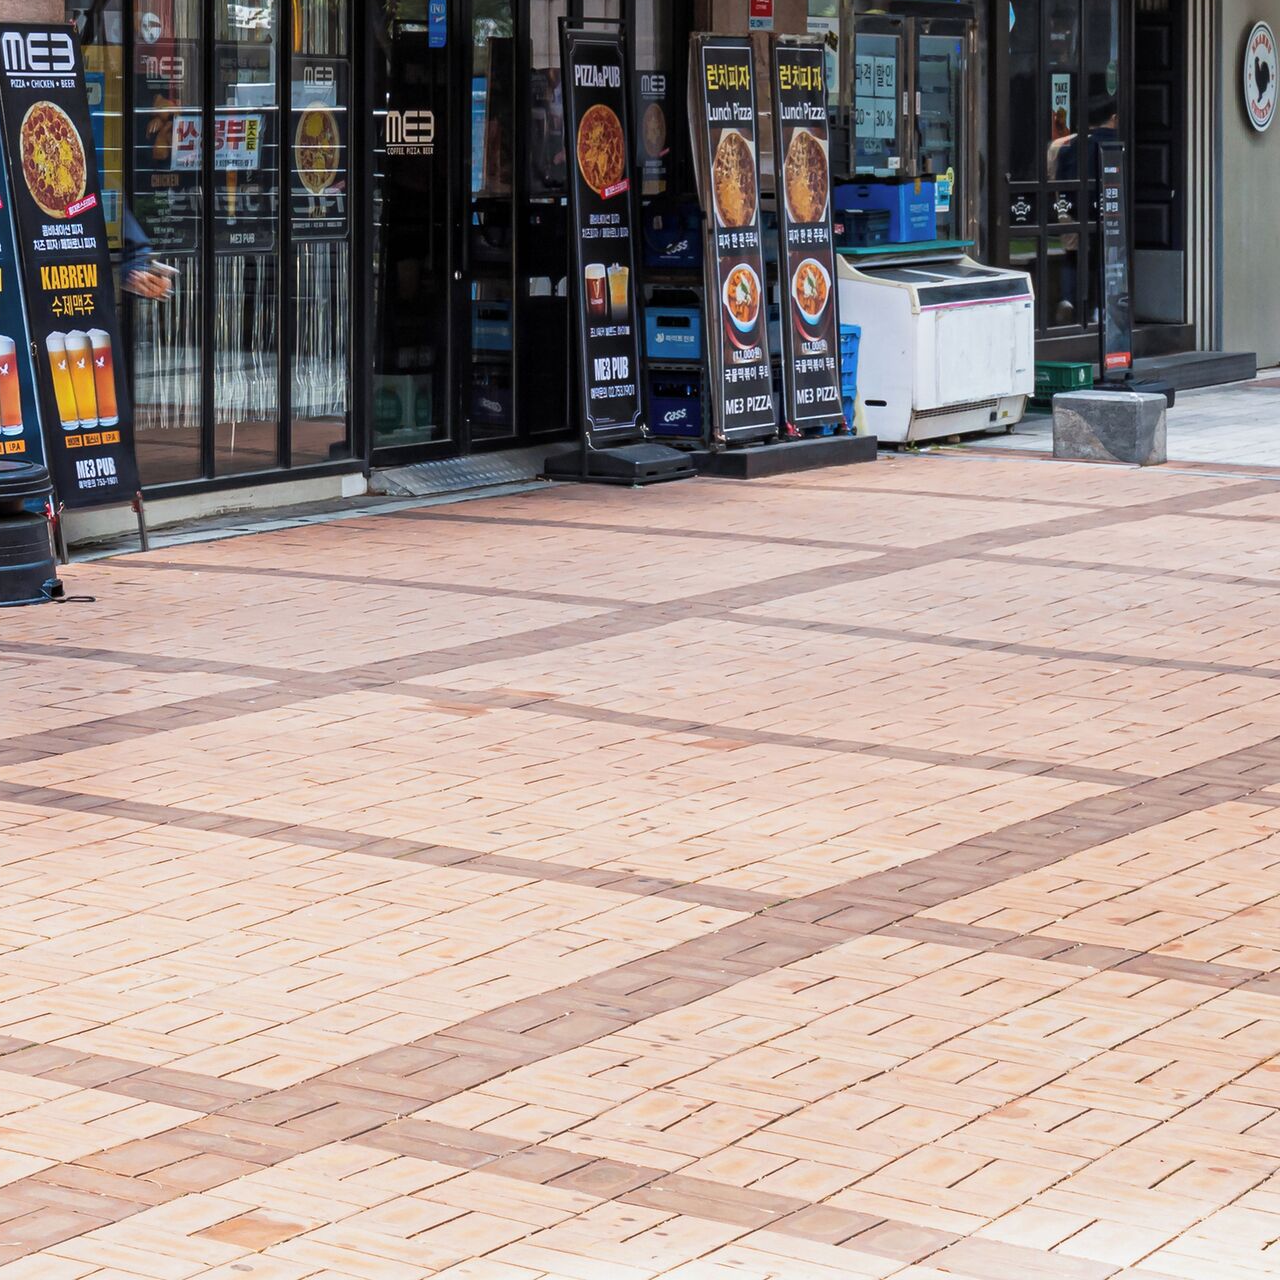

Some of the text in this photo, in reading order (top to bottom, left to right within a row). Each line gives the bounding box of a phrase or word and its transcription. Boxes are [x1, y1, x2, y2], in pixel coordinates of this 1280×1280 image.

[0, 31, 76, 71] ME3
[10, 79, 76, 89] PIZZA CHICKEN BEER
[574, 64, 621, 88] PIZZA&PUB
[706, 64, 751, 91] 런치피자
[779, 65, 822, 91] 런치피자
[876, 64, 893, 87] 할인
[1054, 82, 1068, 94] TAKE
[1055, 95, 1067, 105] OUT
[708, 102, 752, 120] Lunch Pizza
[780, 102, 827, 120] Lunch Pizza
[385, 110, 435, 143] ME3
[33, 240, 46, 251] 치즈
[718, 233, 730, 249] 피자
[732, 233, 738, 248] 한
[788, 229, 800, 243] 피자
[800, 228, 806, 243] 한
[813, 228, 829, 242] 주문시
[40, 263, 98, 291] KABREW
[51, 293, 95, 318] 수제맥주
[594, 356, 629, 382] ME3 PUB
[725, 367, 757, 384] 국물떡볶이
[795, 359, 825, 374] 국물떡볶이
[725, 394, 772, 415] ME3 PIZZA
[797, 385, 840, 405] ME3 PIZZA
[75, 456, 116, 480] ME3 PUB
